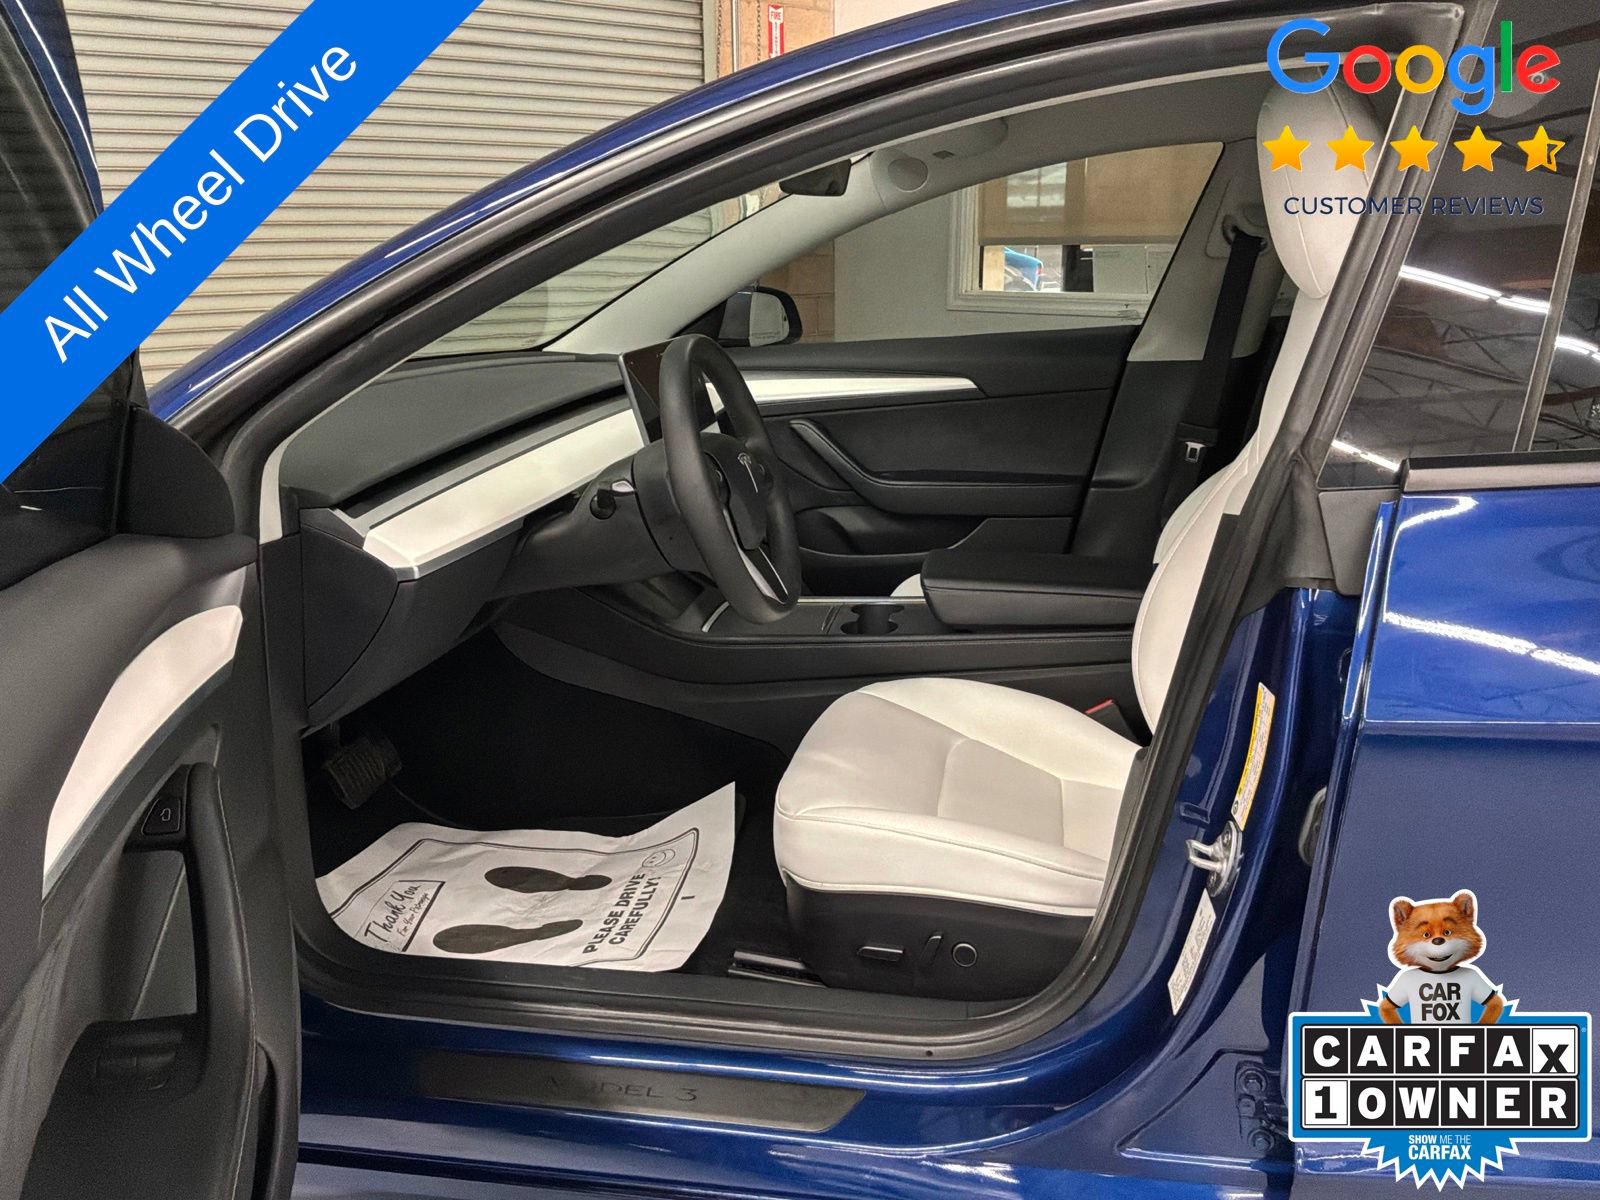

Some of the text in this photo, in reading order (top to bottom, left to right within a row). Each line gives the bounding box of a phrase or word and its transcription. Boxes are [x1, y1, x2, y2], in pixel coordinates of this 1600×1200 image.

[364, 885, 421, 942] Thank You
[582, 873, 646, 954] PLEASE DRIVE
[608, 876, 662, 945] CAREFULLY!
[545, 1075, 698, 1102] MDEL 3
